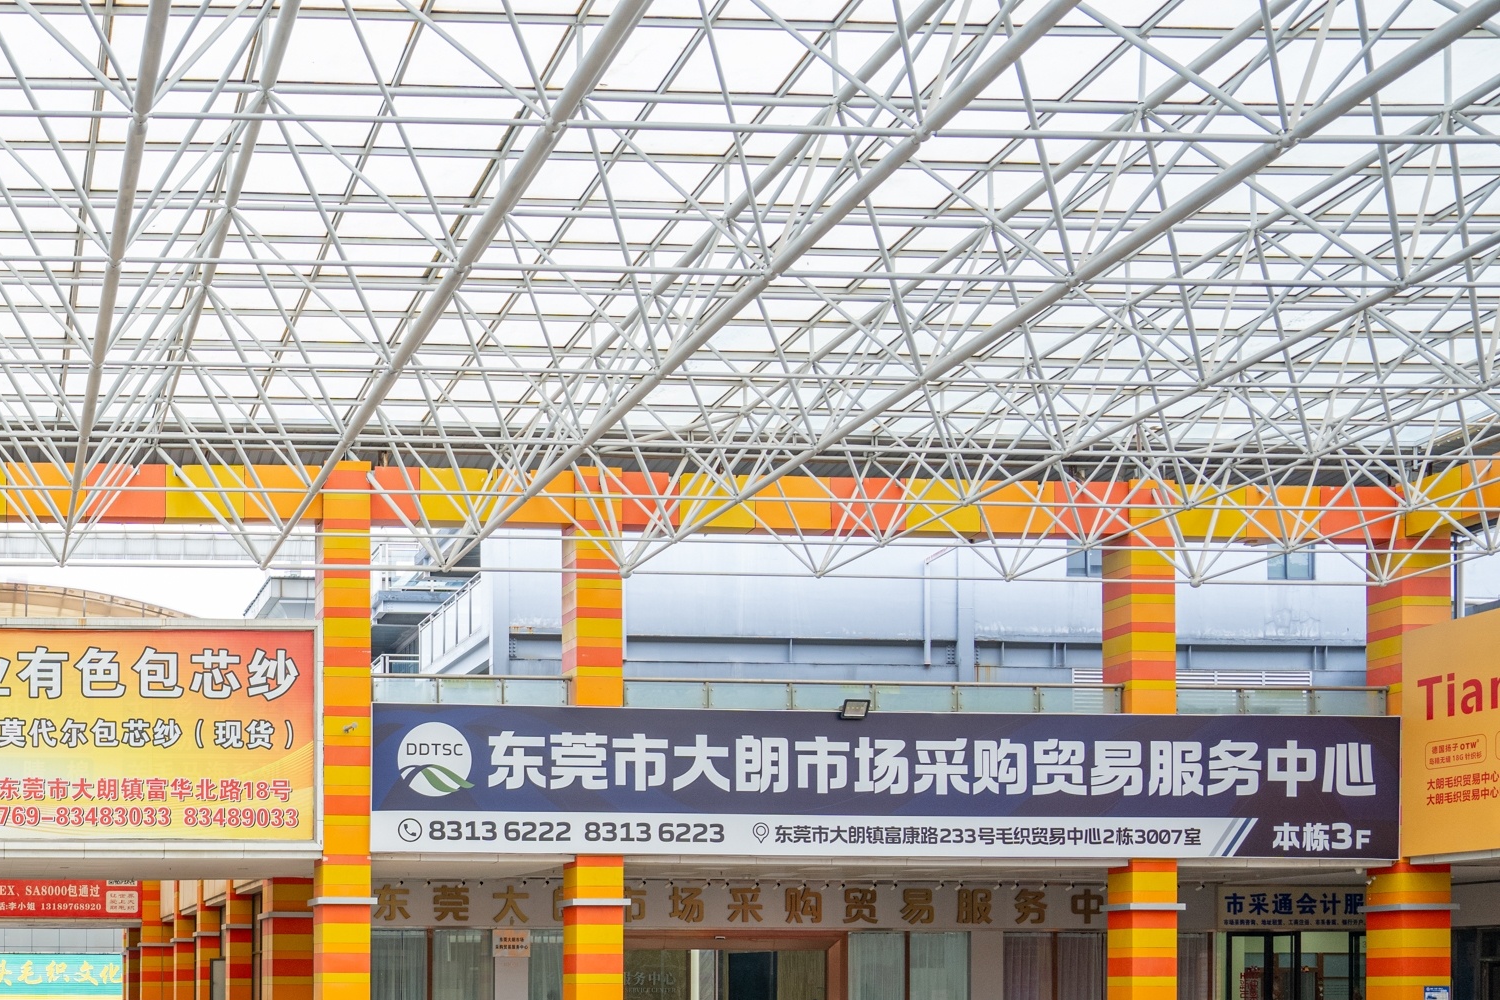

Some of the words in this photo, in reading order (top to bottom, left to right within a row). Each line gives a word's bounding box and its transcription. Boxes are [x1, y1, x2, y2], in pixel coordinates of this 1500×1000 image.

[405, 742, 463, 756] DDTSC
[1452, 753, 1464, 761] 18G
[487, 730, 1377, 798] 东莞市大朗市场采购贸易服务中心
[184, 805, 300, 829] 83489033
[428, 821, 498, 842] 8313
[504, 821, 571, 842] 6222
[584, 822, 652, 842] 8313
[658, 822, 725, 843] 6223
[1272, 822, 1371, 851] 本栋3F
